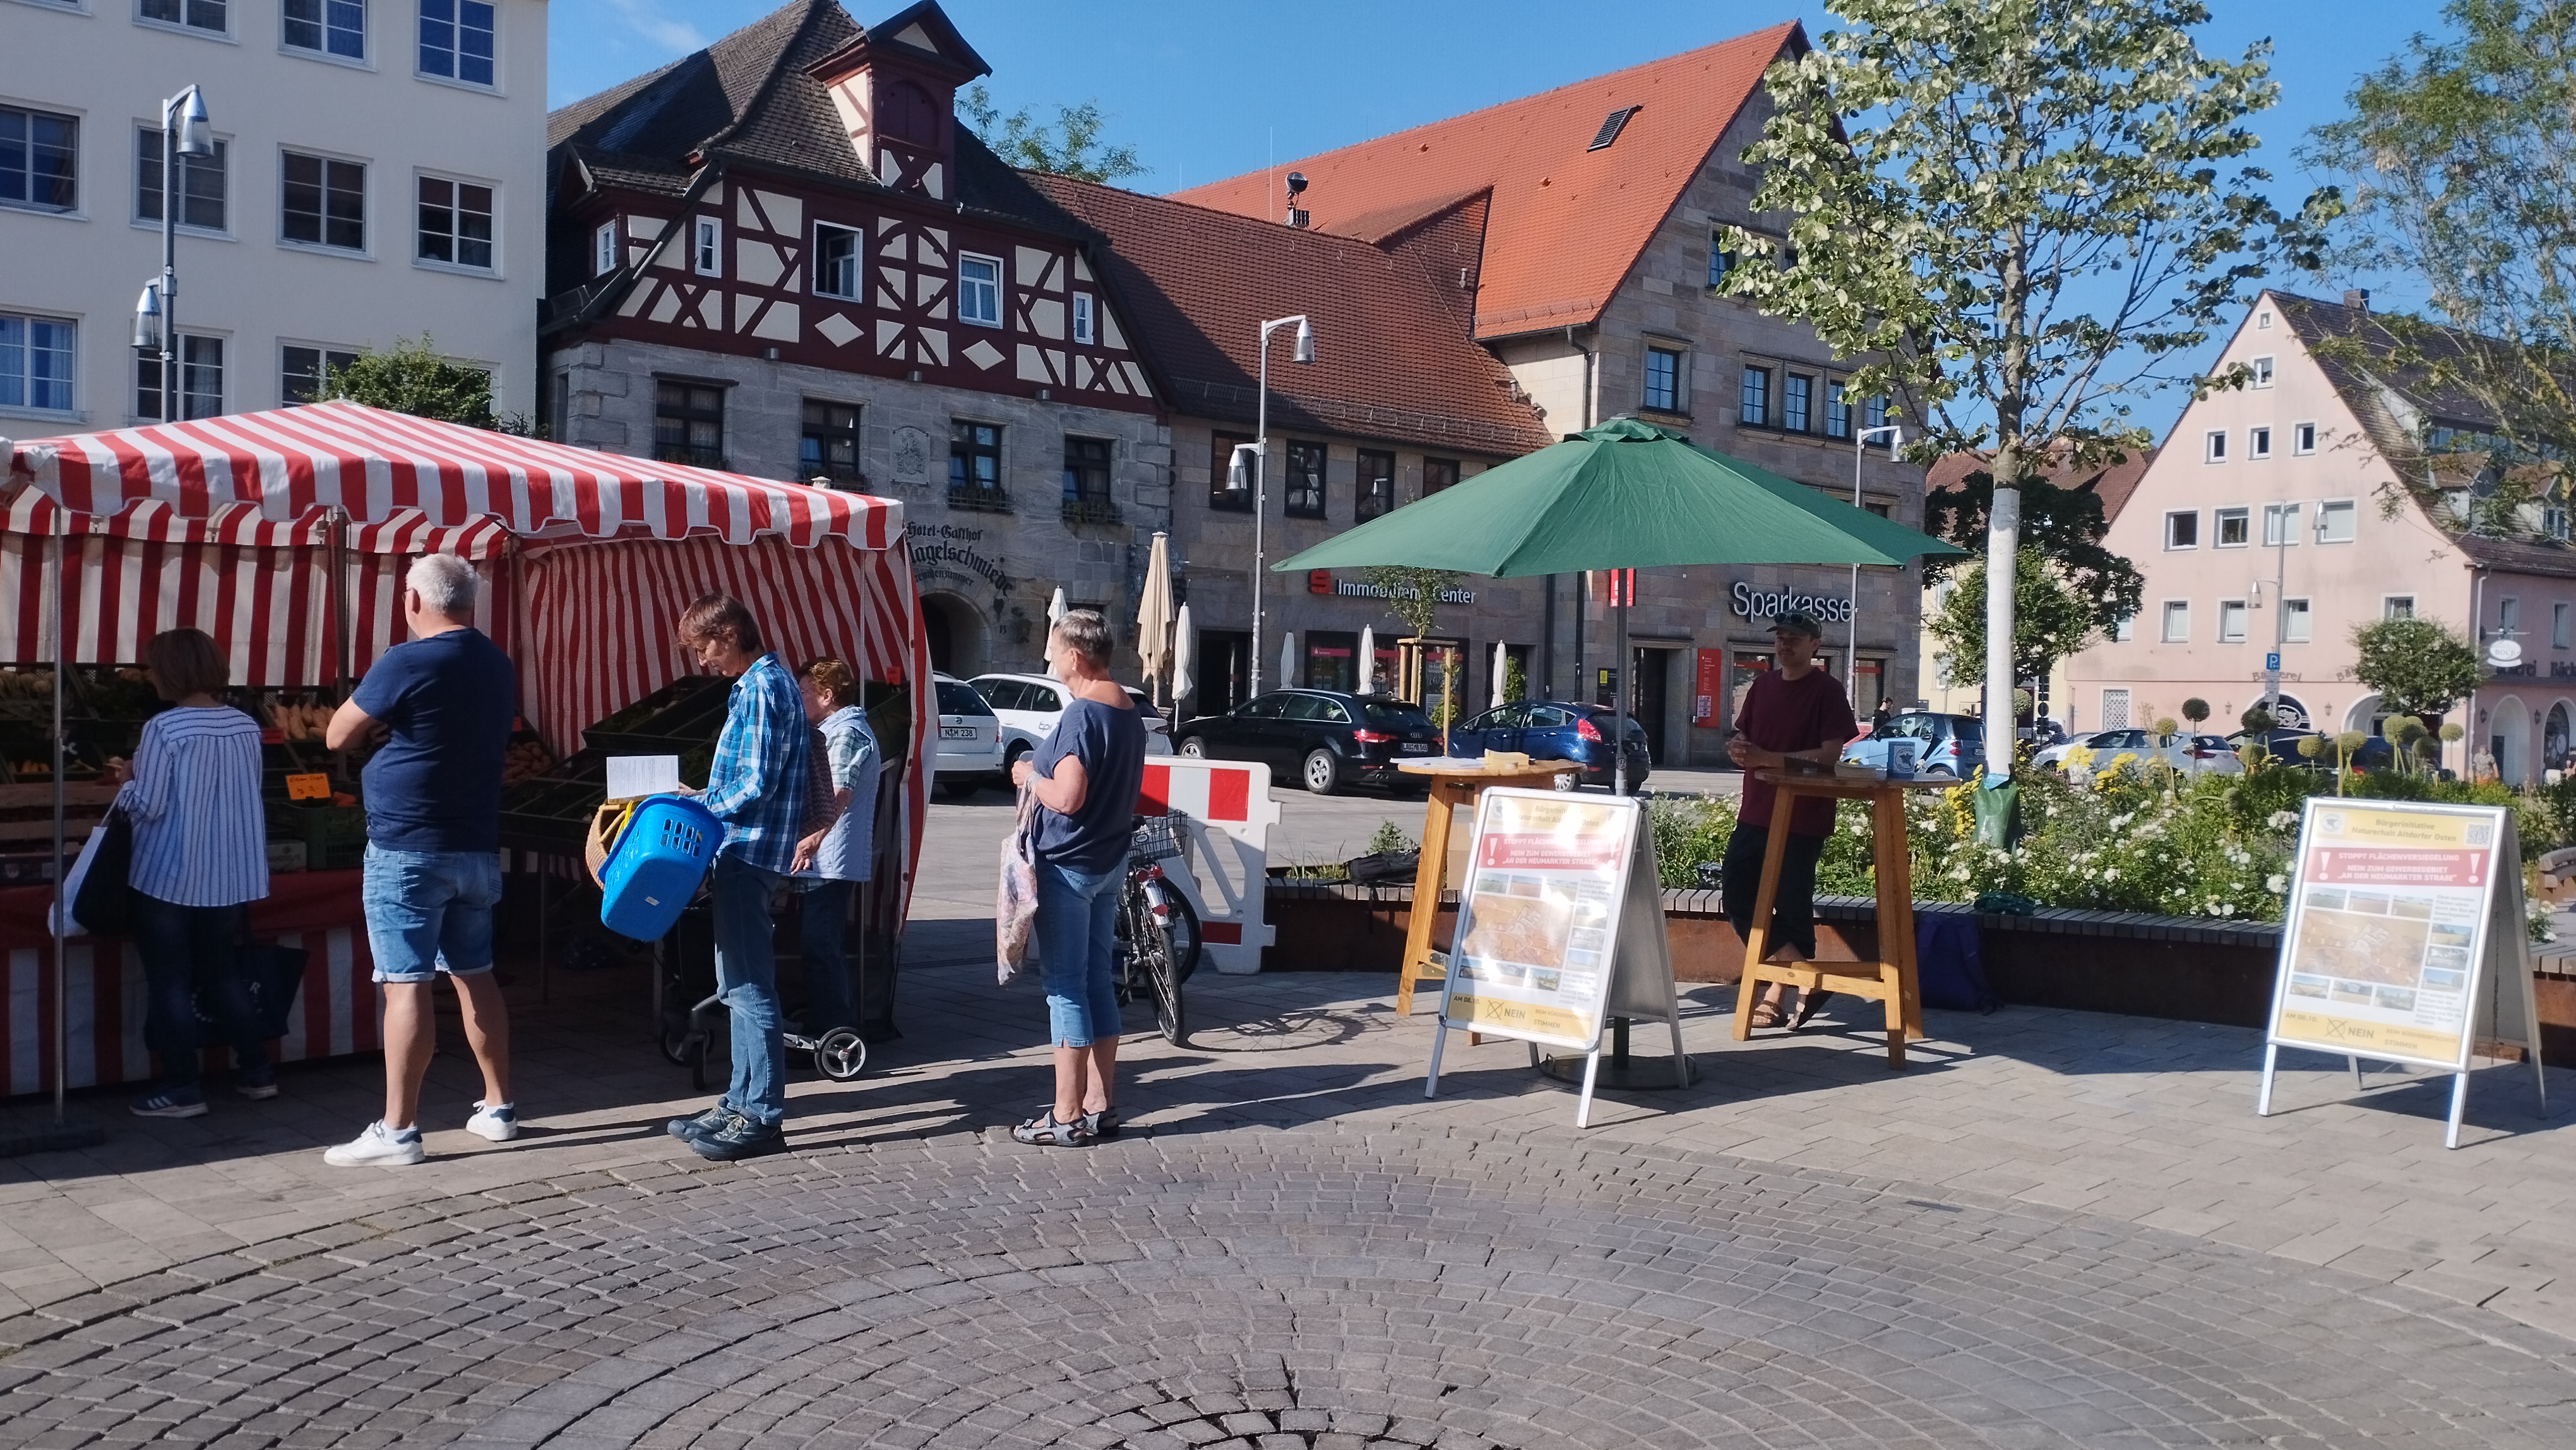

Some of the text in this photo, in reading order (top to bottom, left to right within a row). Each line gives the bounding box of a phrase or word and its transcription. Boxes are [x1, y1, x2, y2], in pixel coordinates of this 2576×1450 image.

[914, 568, 974, 586] remdenzimmer
[1734, 582, 1852, 623] Sparkasse
[2252, 671, 2302, 681] Bäerei
[1518, 814, 1551, 823] aturerhalt
[2376, 819, 2435, 830] Bürgerinitiative
[2351, 827, 2457, 842] Naturerhalt Altdorfer Osten
[2368, 852, 2459, 861] FLÄCHENVERSIEGELUNG
[1464, 997, 1481, 1005] 08.10.
[1505, 1008, 1525, 1019] NEIN
[1547, 1009, 1592, 1022] BÜRGERENTSCHEID
[1533, 1019, 1561, 1029] STIMMEN
[2348, 1027, 2374, 1040] NEIN
[2401, 1030, 2457, 1043] BÜRGERENTSCHEID
[2384, 1039, 2418, 1050] STIMMEN
